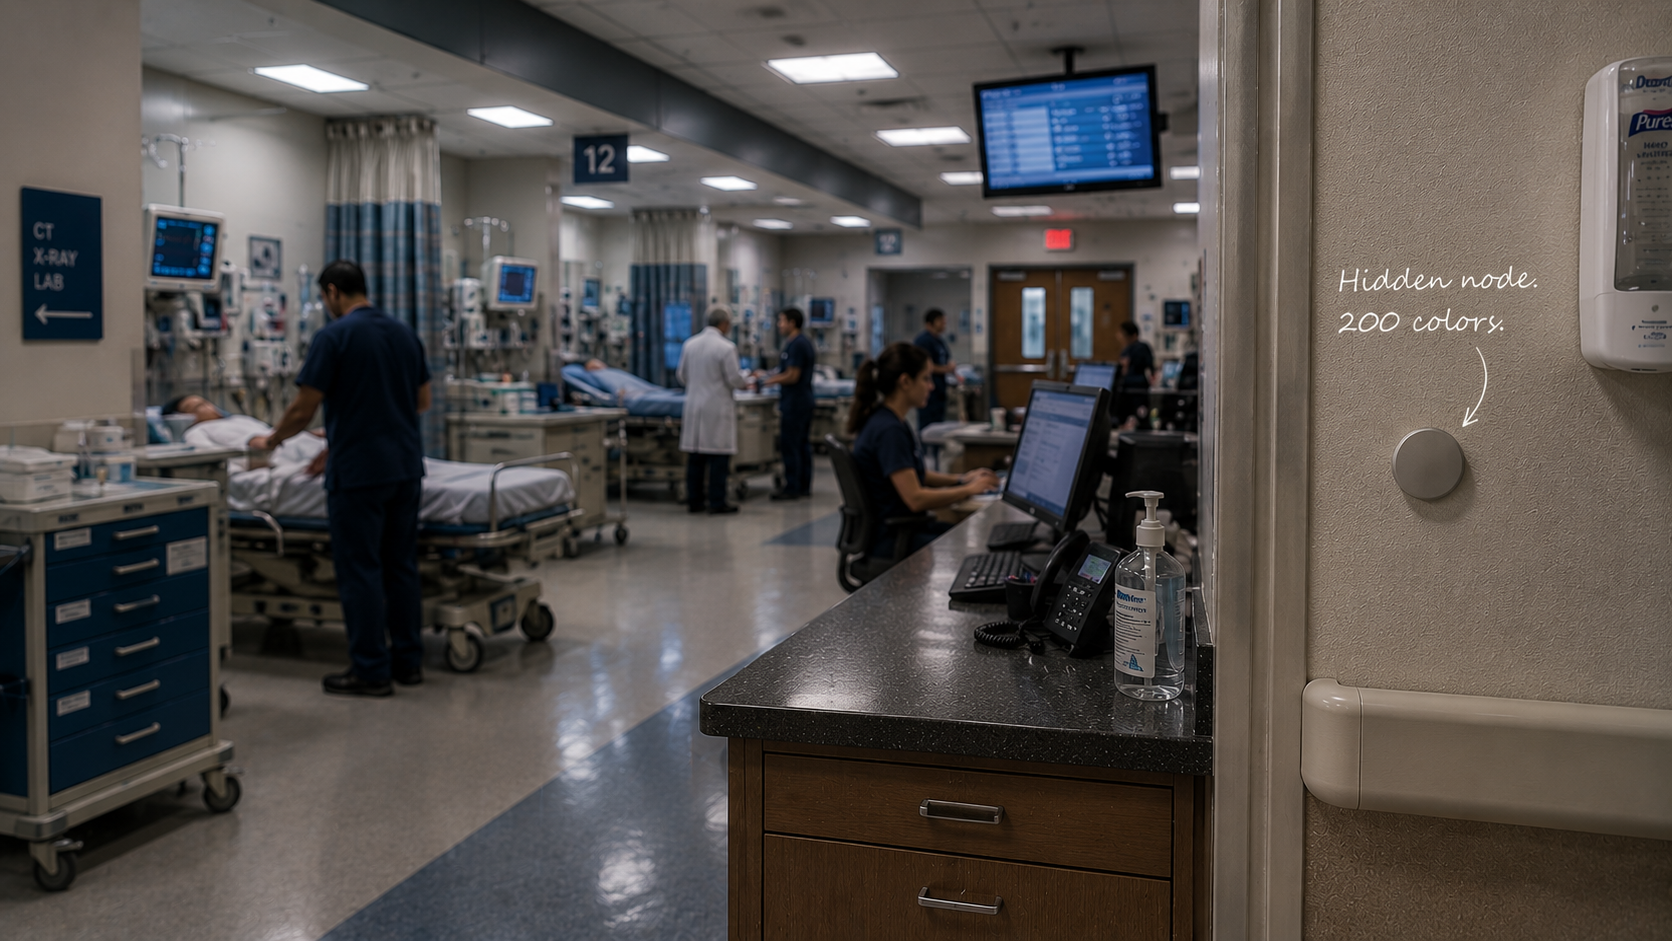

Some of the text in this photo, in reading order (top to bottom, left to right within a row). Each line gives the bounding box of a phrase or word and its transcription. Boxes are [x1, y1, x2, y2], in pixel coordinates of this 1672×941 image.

[1635, 114, 1672, 131] Pure
[583, 144, 616, 175] 12
[33, 221, 54, 240] CT
[33, 247, 78, 267] X-RAY
[33, 272, 64, 291] LAB
